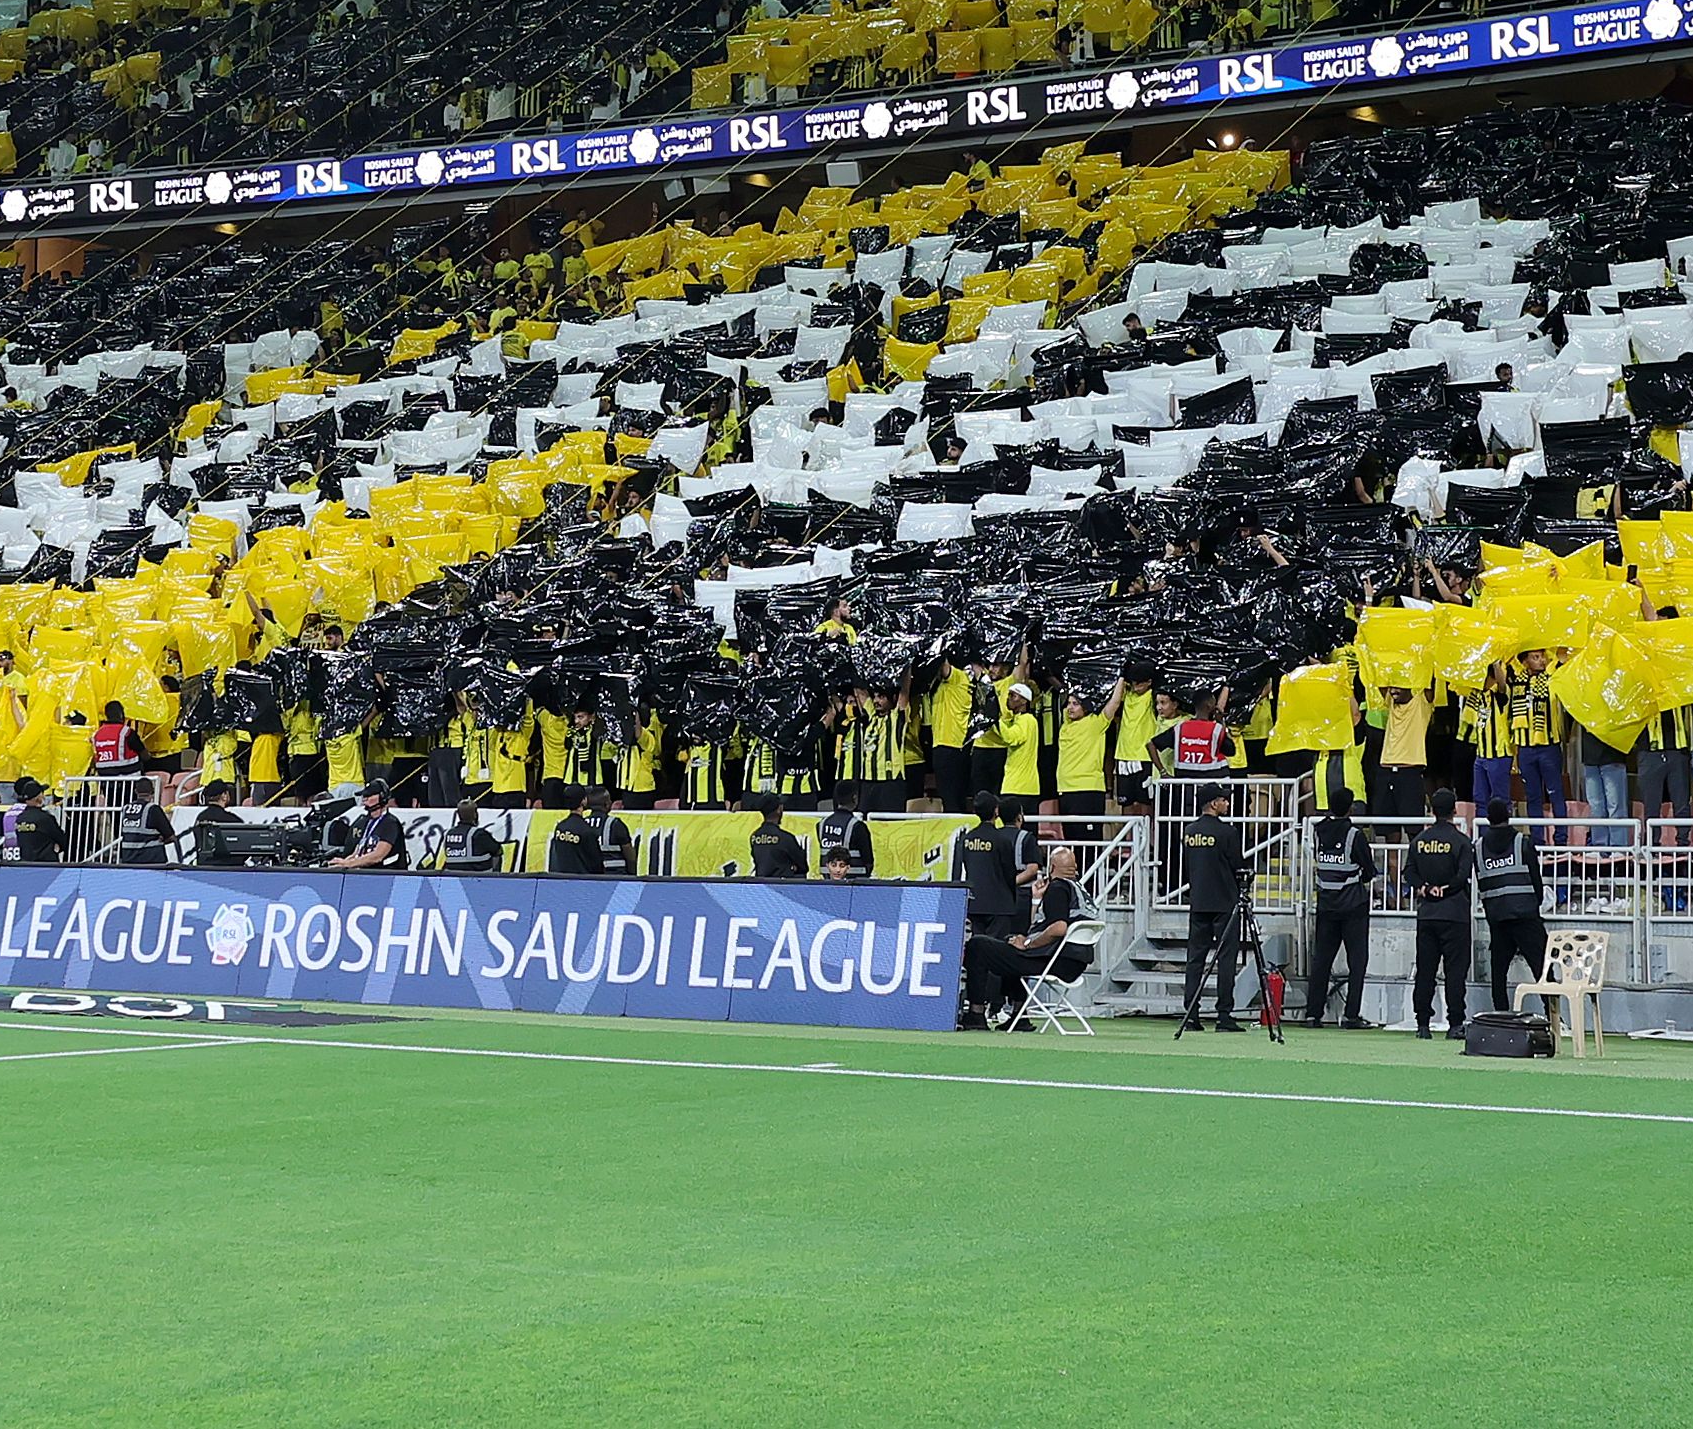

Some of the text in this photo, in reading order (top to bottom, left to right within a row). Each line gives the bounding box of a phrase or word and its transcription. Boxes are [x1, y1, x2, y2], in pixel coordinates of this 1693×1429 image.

[1491, 16, 1559, 59] RSL
[1304, 57, 1365, 82] LEAGUE
[513, 140, 565, 174] RSL
[365, 168, 413, 187] LEAGUE
[1185, 752, 1204, 763] 217
[123, 818, 141, 828] Guard
[555, 830, 580, 844] Police
[751, 833, 779, 845] Police
[1184, 834, 1215, 847] Police
[964, 838, 991, 851] Police
[1417, 840, 1450, 855] Police
[446, 847, 466, 857] Guard
[1318, 851, 1344, 864] Guard
[1485, 854, 1513, 870] Guard
[0, 896, 199, 965] LEAGUE
[260, 903, 946, 996] ROSHN SAUDI LEAGUE
